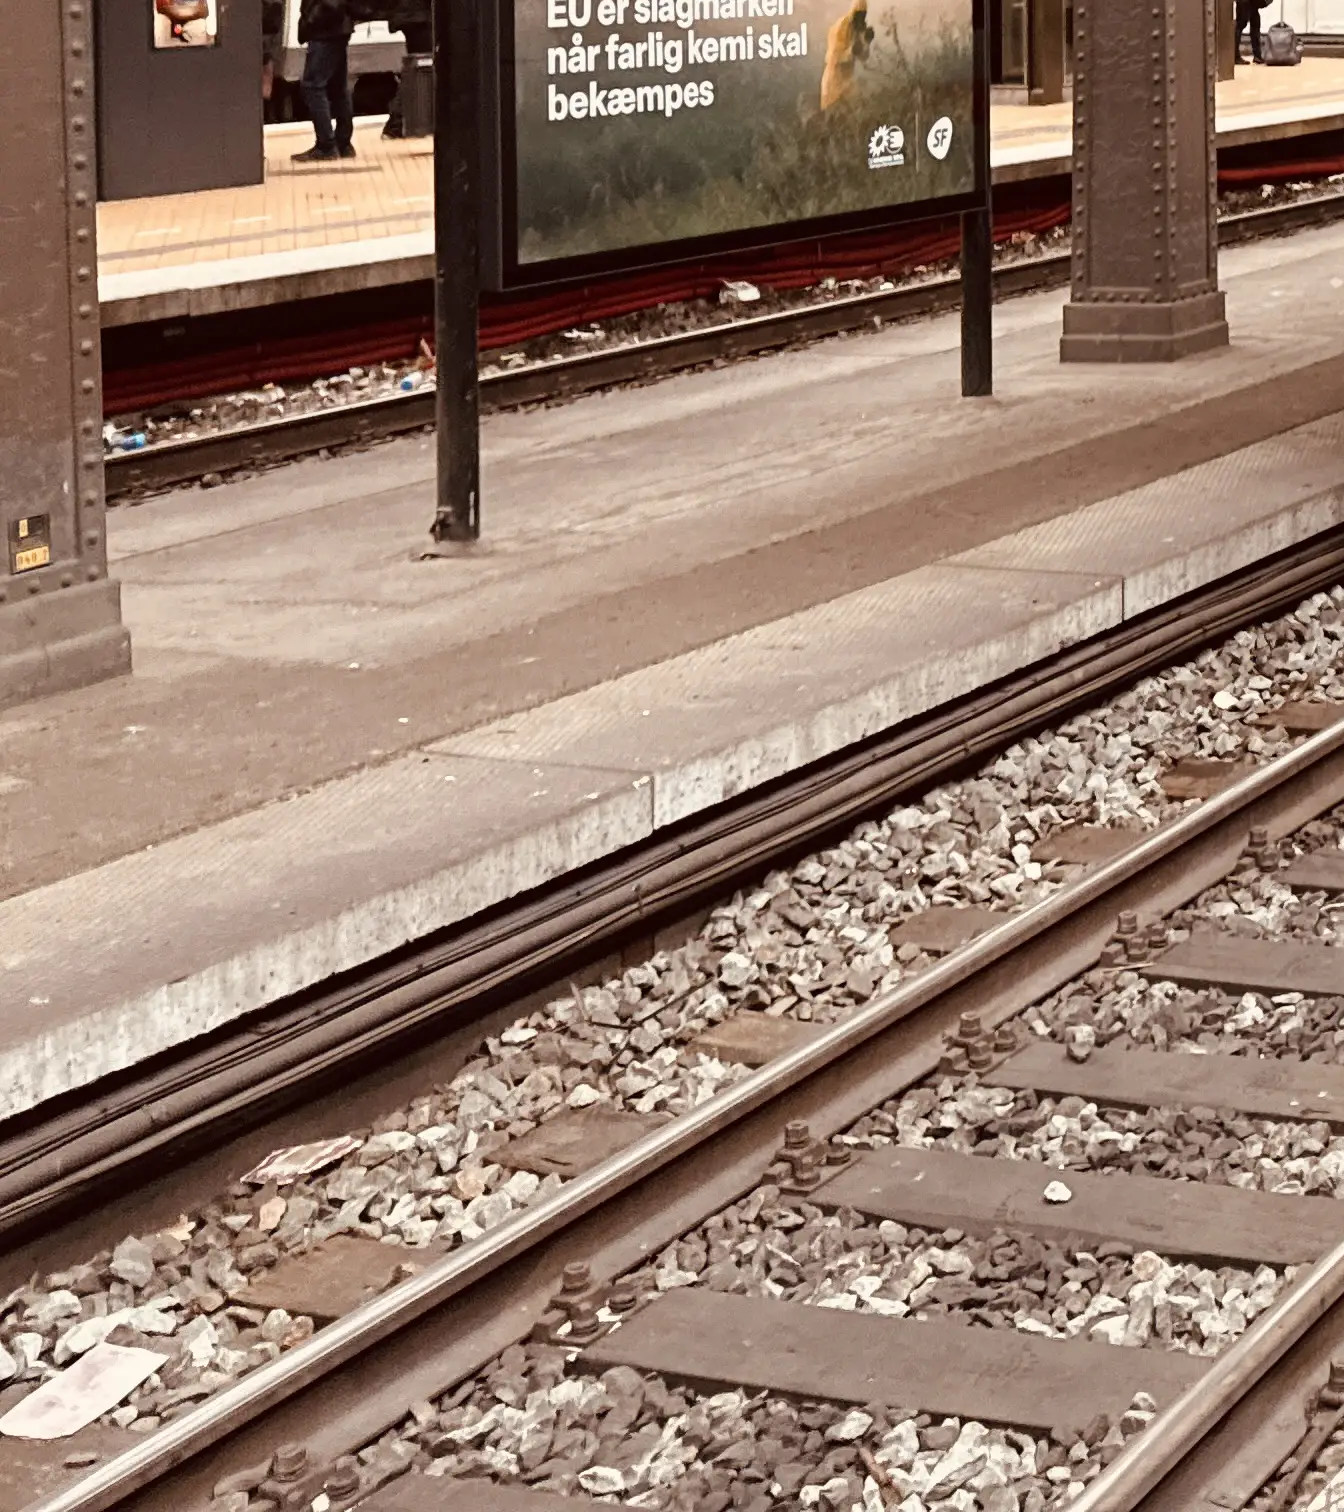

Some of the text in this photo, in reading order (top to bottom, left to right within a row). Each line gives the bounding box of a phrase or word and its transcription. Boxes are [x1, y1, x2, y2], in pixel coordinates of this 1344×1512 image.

[547, 22, 808, 75] når farlig kemi skal
[547, 79, 715, 122] bekæmpes
